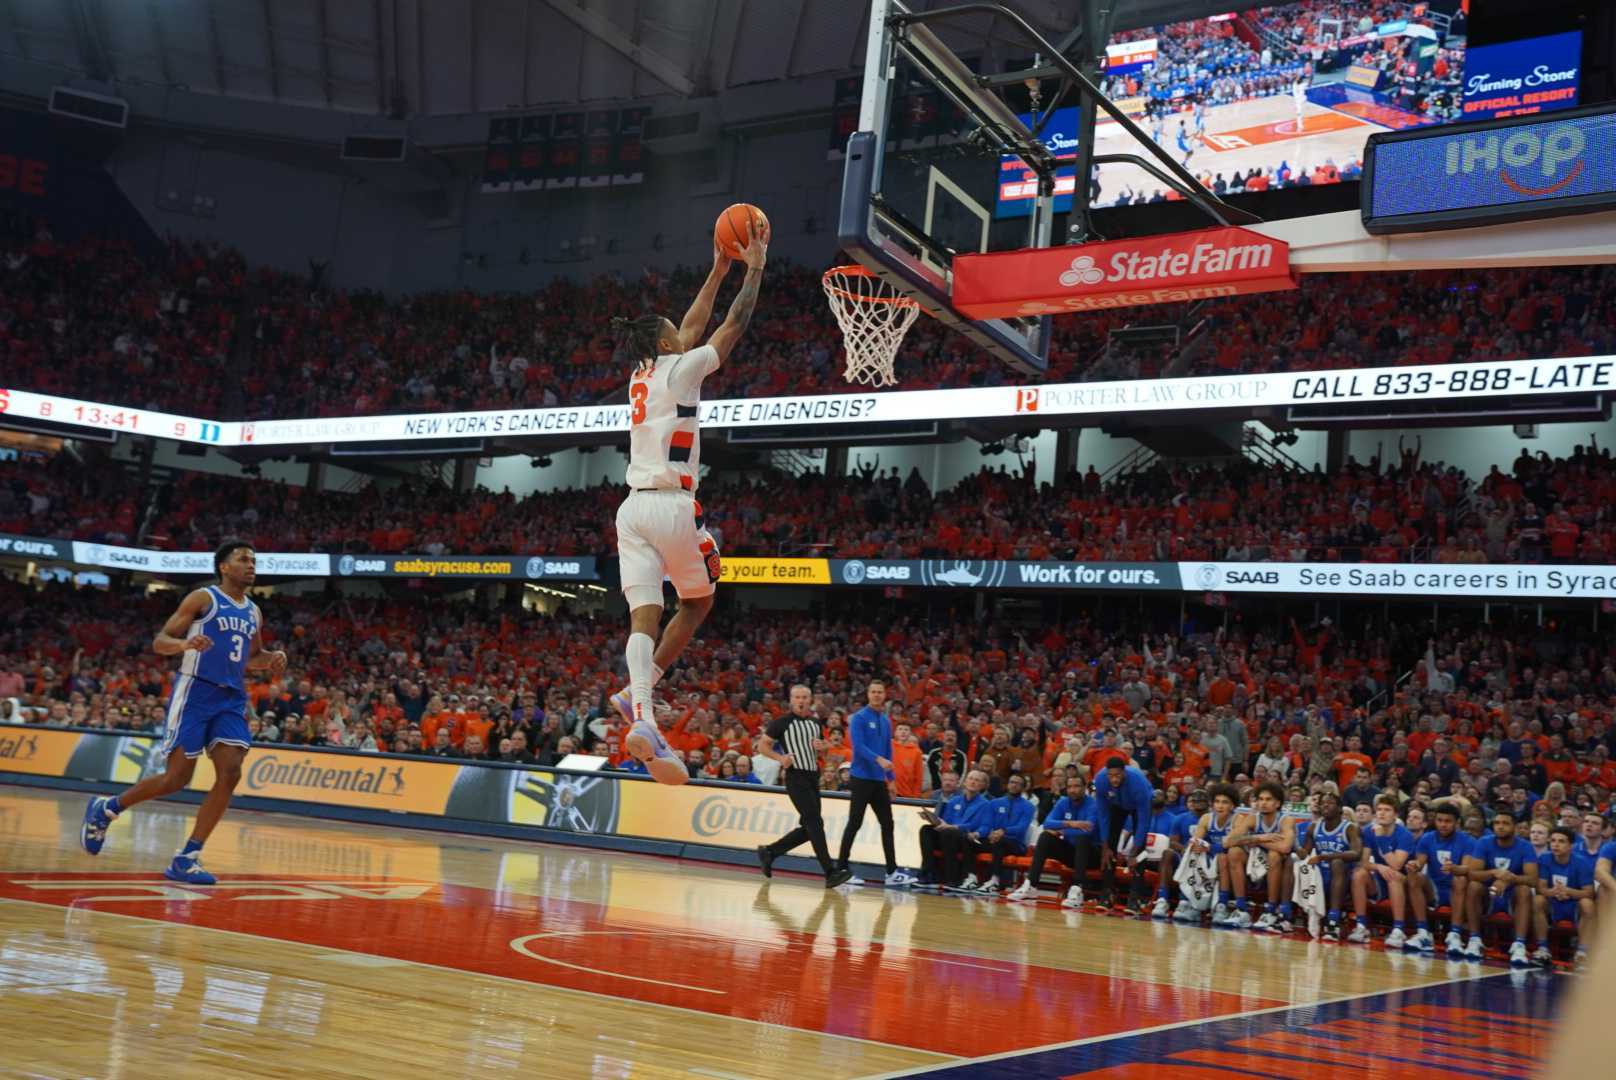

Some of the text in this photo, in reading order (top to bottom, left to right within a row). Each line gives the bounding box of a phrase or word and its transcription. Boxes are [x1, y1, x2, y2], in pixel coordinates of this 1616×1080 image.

[1464, 65, 1576, 96] Turning Stone
[1464, 87, 1576, 113] OFFICIAL RESORT
[1045, 387, 1126, 407] PORTER
[1134, 384, 1179, 404] LAW
[1186, 380, 1268, 401] GROUP
[1292, 363, 1613, 399] CALL 833-888-LATE
[404, 419, 442, 435] NEW
[447, 416, 502, 433] YORK'S
[508, 412, 579, 431] CANCER
[584, 409, 631, 427] LAWY
[750, 398, 876, 422] DIAGNOSIS?
[631, 382, 648, 425] 3
[40, 402, 52, 416] 8
[74, 406, 139, 429] 13:41
[175, 423, 186, 437] 9
[13, 540, 58, 557] ours.
[109, 552, 149, 566] SAAB
[161, 556, 183, 569] See
[354, 558, 511, 576] SAAB saabsyracuse.com
[544, 562, 580, 574] SAAB
[733, 564, 765, 581] your
[772, 562, 816, 578] team.
[866, 565, 910, 579] SAAB
[1019, 564, 1160, 585] Work for ours.
[1226, 571, 1279, 584] SAAB
[1299, 568, 1341, 586] See
[1348, 568, 1406, 587] Saab
[1414, 571, 1508, 589] careers
[1517, 570, 1537, 589] in
[229, 634, 244, 662] 3
[247, 755, 386, 793] Continental
